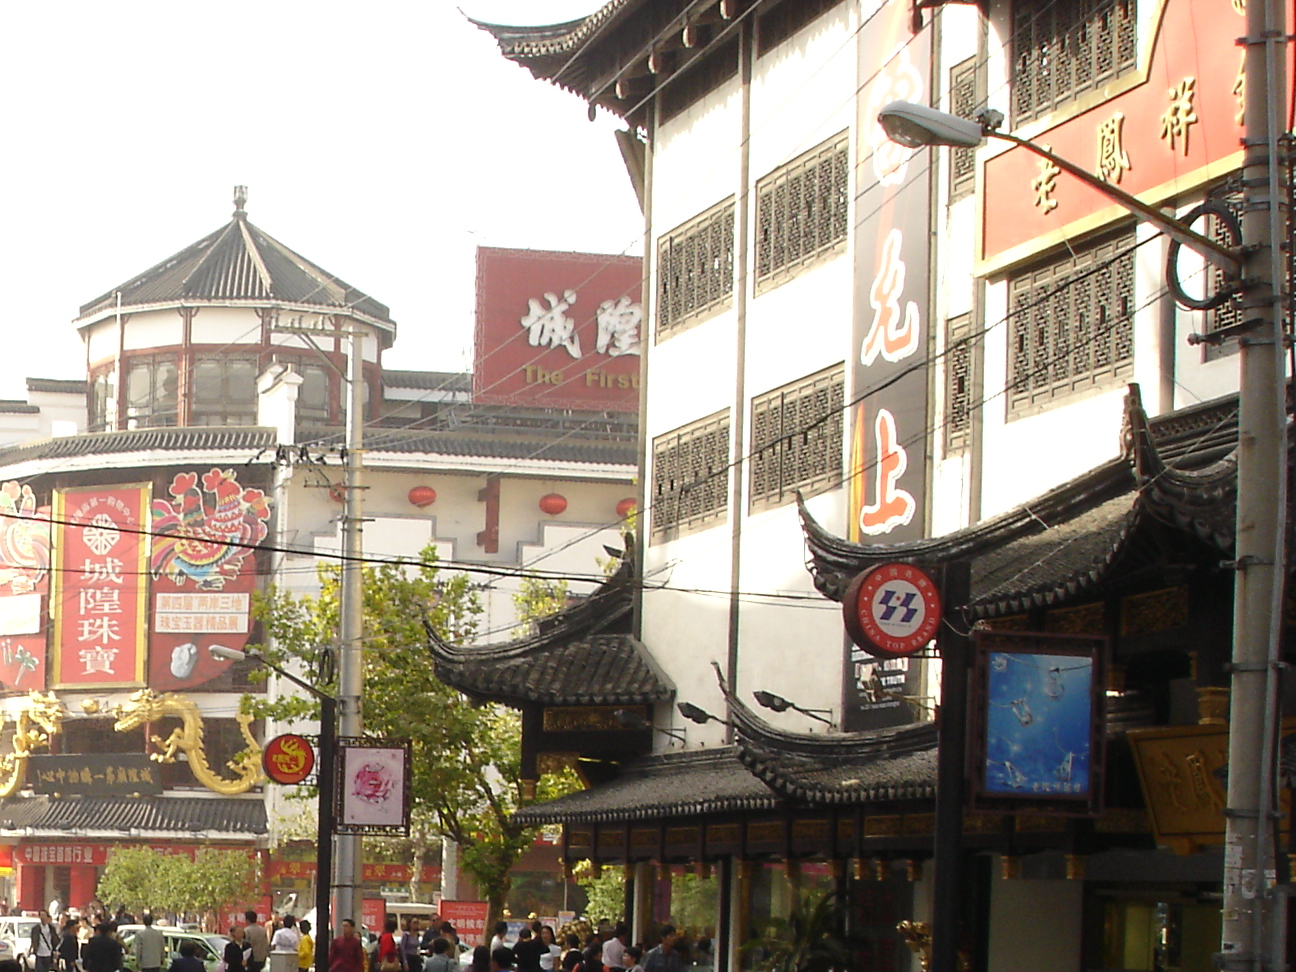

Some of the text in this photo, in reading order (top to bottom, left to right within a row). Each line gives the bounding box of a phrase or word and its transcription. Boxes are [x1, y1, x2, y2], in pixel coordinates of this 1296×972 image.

[521, 289, 642, 359] 城隍
[524, 366, 640, 389] The First
[77, 557, 124, 676] 城隍珠寶
